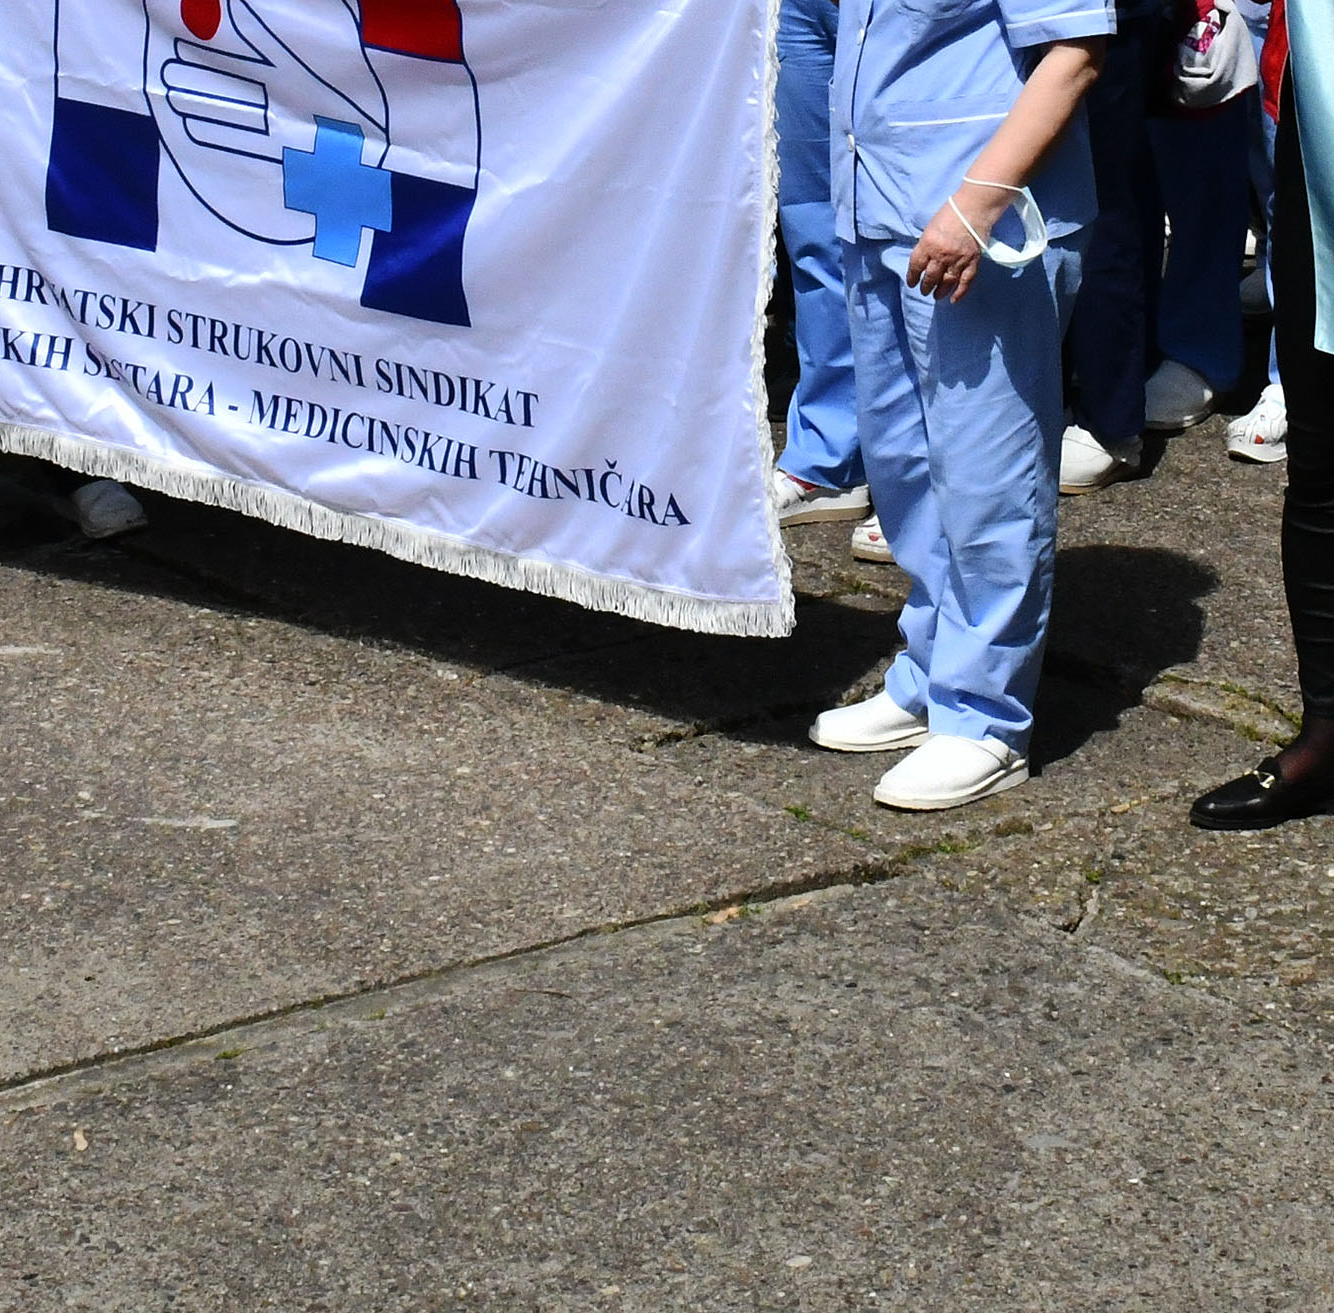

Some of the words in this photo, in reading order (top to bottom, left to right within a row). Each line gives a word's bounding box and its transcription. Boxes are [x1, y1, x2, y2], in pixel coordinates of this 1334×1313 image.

[166, 308, 367, 388] STRUKOVNI
[375, 358, 539, 428] SINDIKAT
[249, 389, 482, 480] MEDICINSKIH
[489, 450, 692, 526] TEHNIČARA
